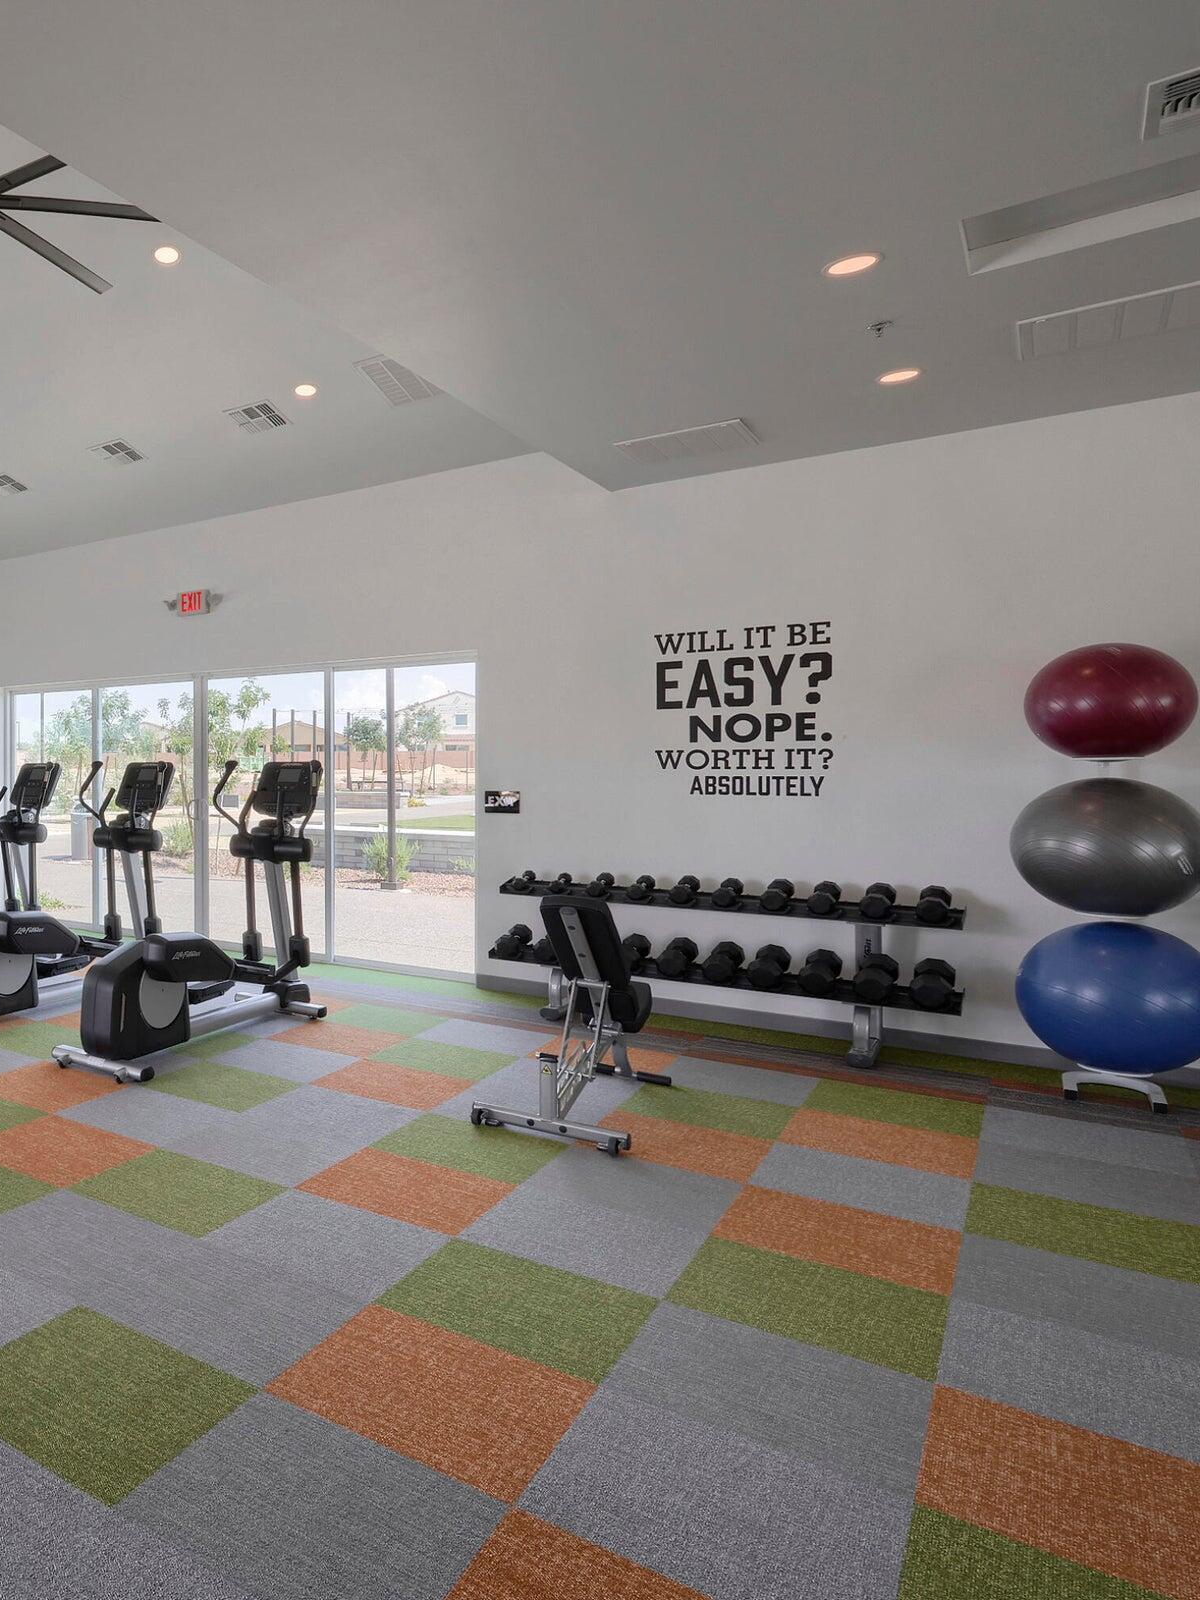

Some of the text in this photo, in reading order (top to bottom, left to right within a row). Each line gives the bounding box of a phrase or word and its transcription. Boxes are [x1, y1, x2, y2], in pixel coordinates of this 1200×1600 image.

[181, 591, 202, 612] EXIT
[654, 621, 831, 655] WILL IT BE
[656, 652, 833, 710] EASY?
[689, 711, 833, 743] NOPE.
[655, 748, 834, 770] WORTH IT?
[689, 775, 825, 797] ABSOLUTELY
